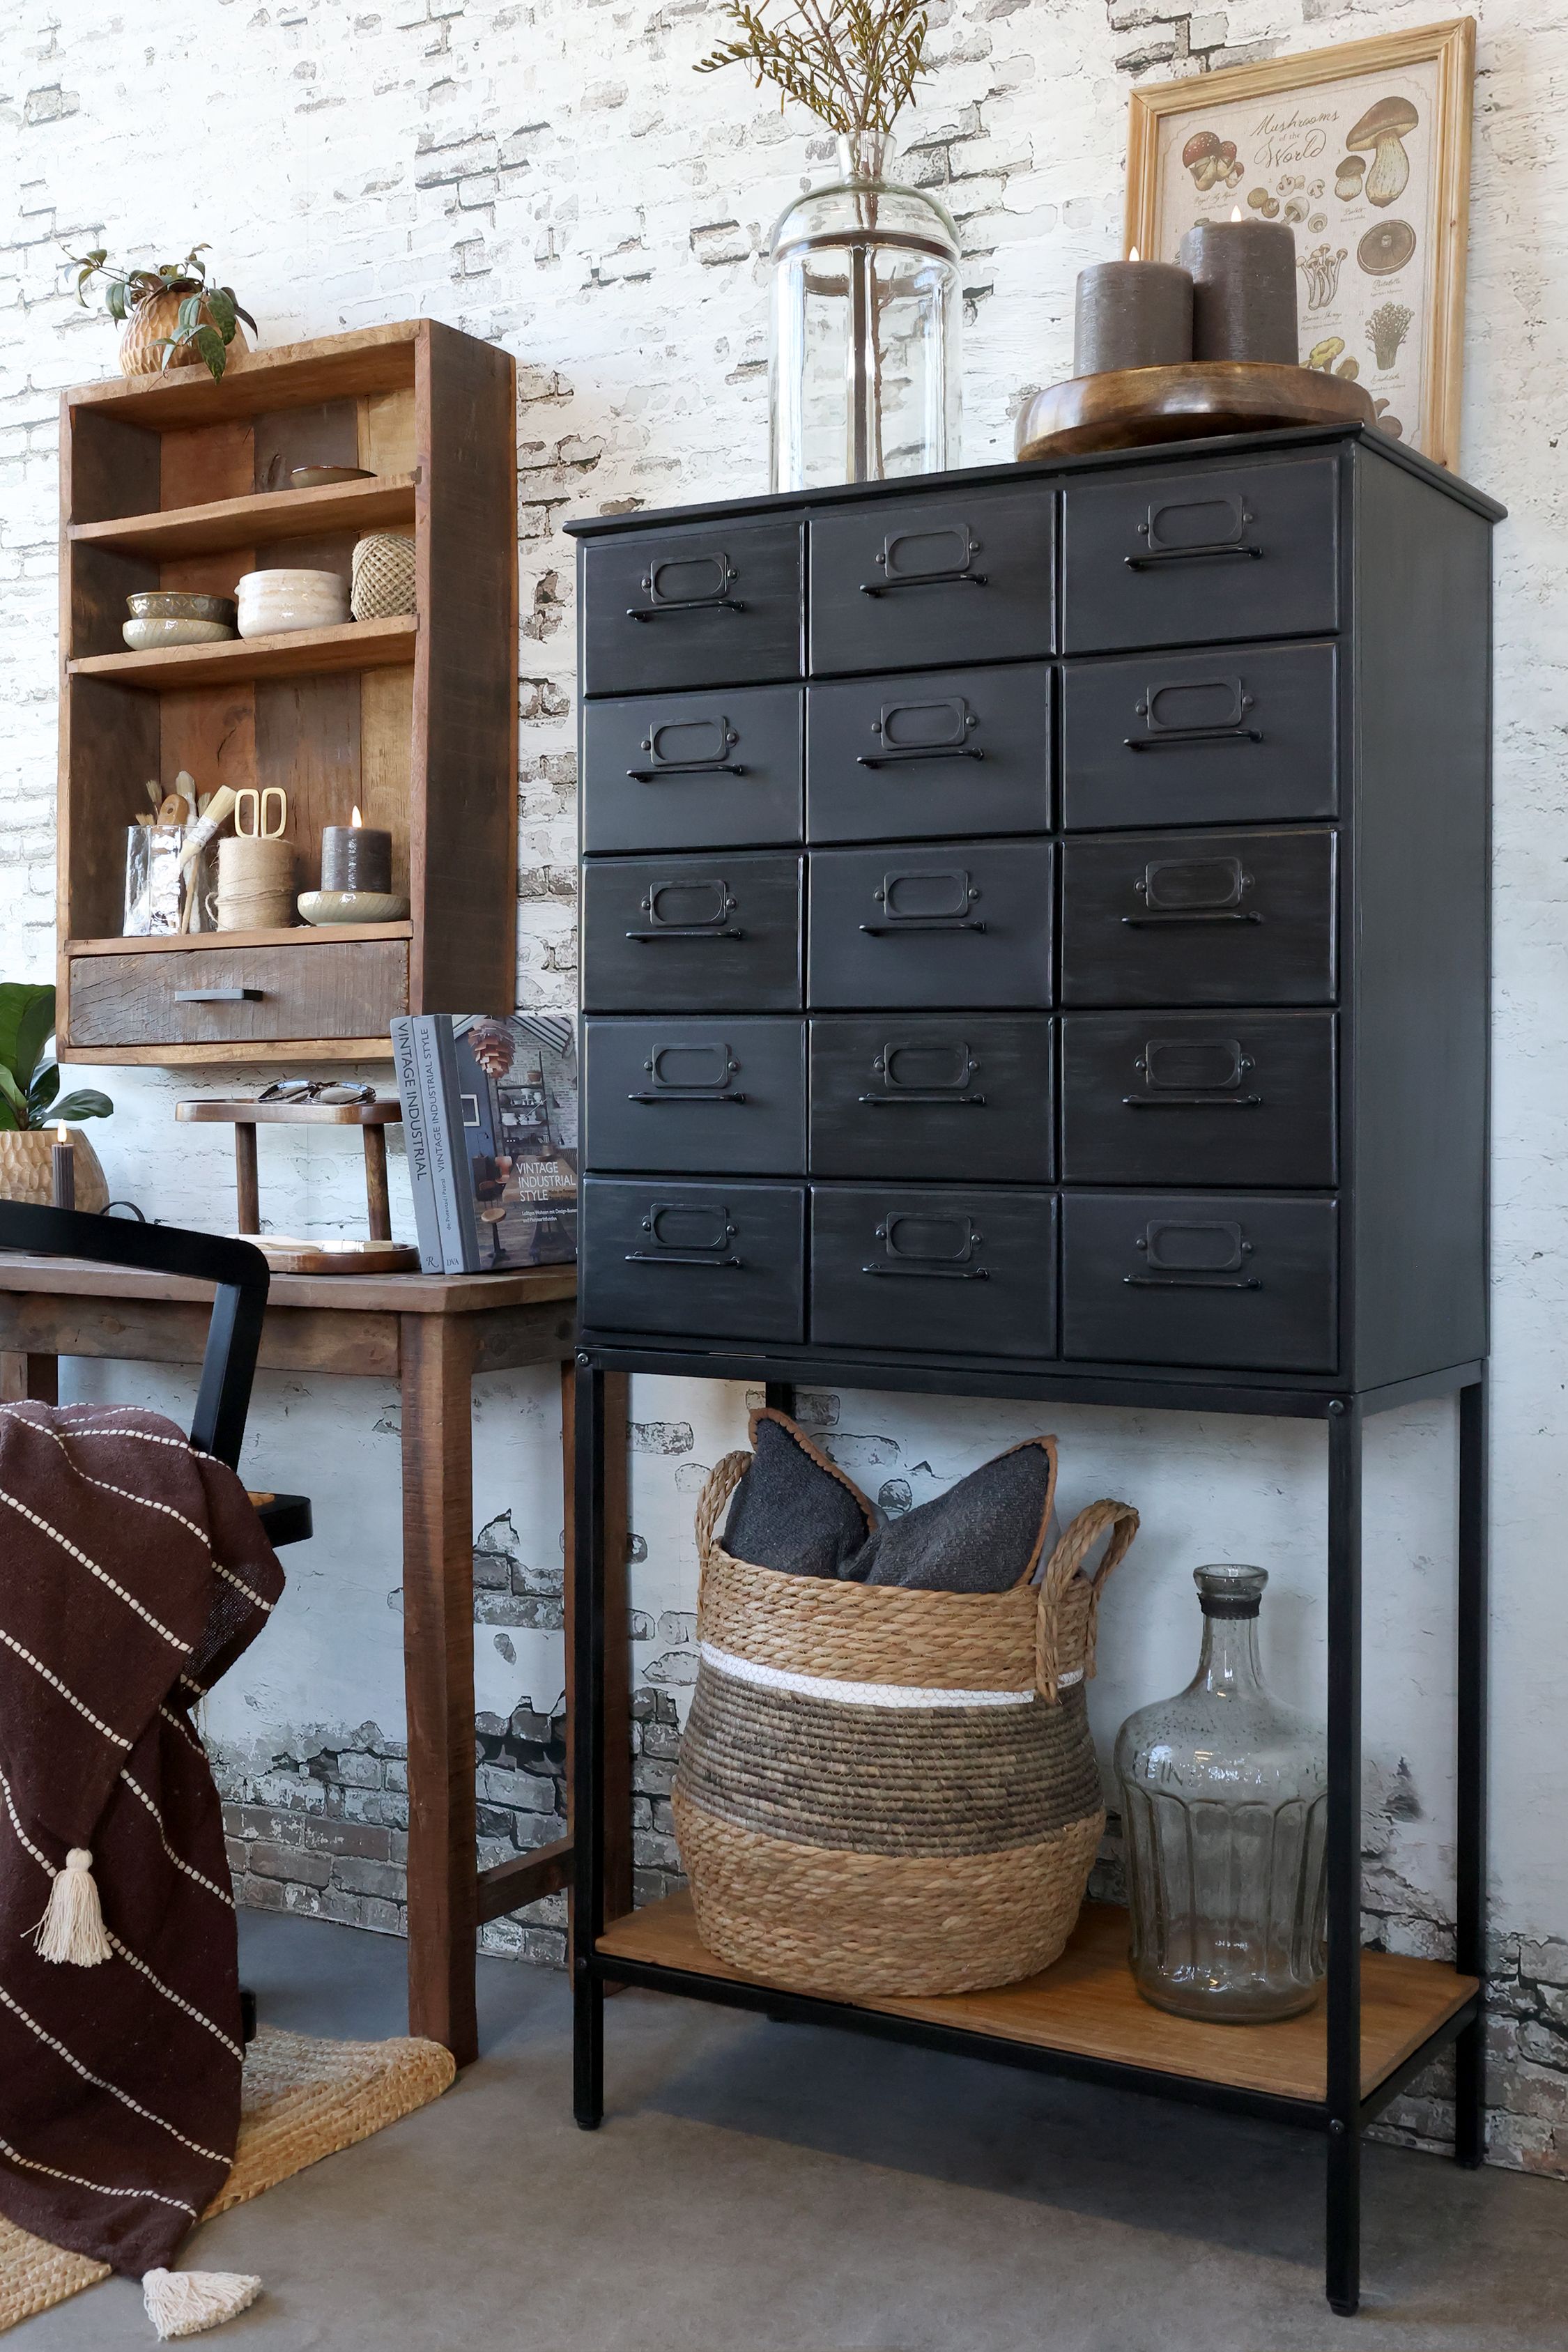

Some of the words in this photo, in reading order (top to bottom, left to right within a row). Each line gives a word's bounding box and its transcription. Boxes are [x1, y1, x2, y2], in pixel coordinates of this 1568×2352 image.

[1250, 110, 1340, 137] Mushrooms
[1279, 133, 1287, 141] of
[1254, 128, 1327, 169] World
[398, 1022, 416, 1087] VINTAGE
[421, 1028, 431, 1059] STYLE
[425, 1061, 439, 1124] INDUSTRIAL
[406, 1091, 427, 1181] INDUSTRIAL
[433, 1126, 445, 1172] VINTAGE
[516, 1162, 558, 1174] VINTAGE
[518, 1174, 576, 1188] INDUSTRIAL
[519, 1189, 548, 1201] STYLE
[447, 1258, 459, 1267] DVA
